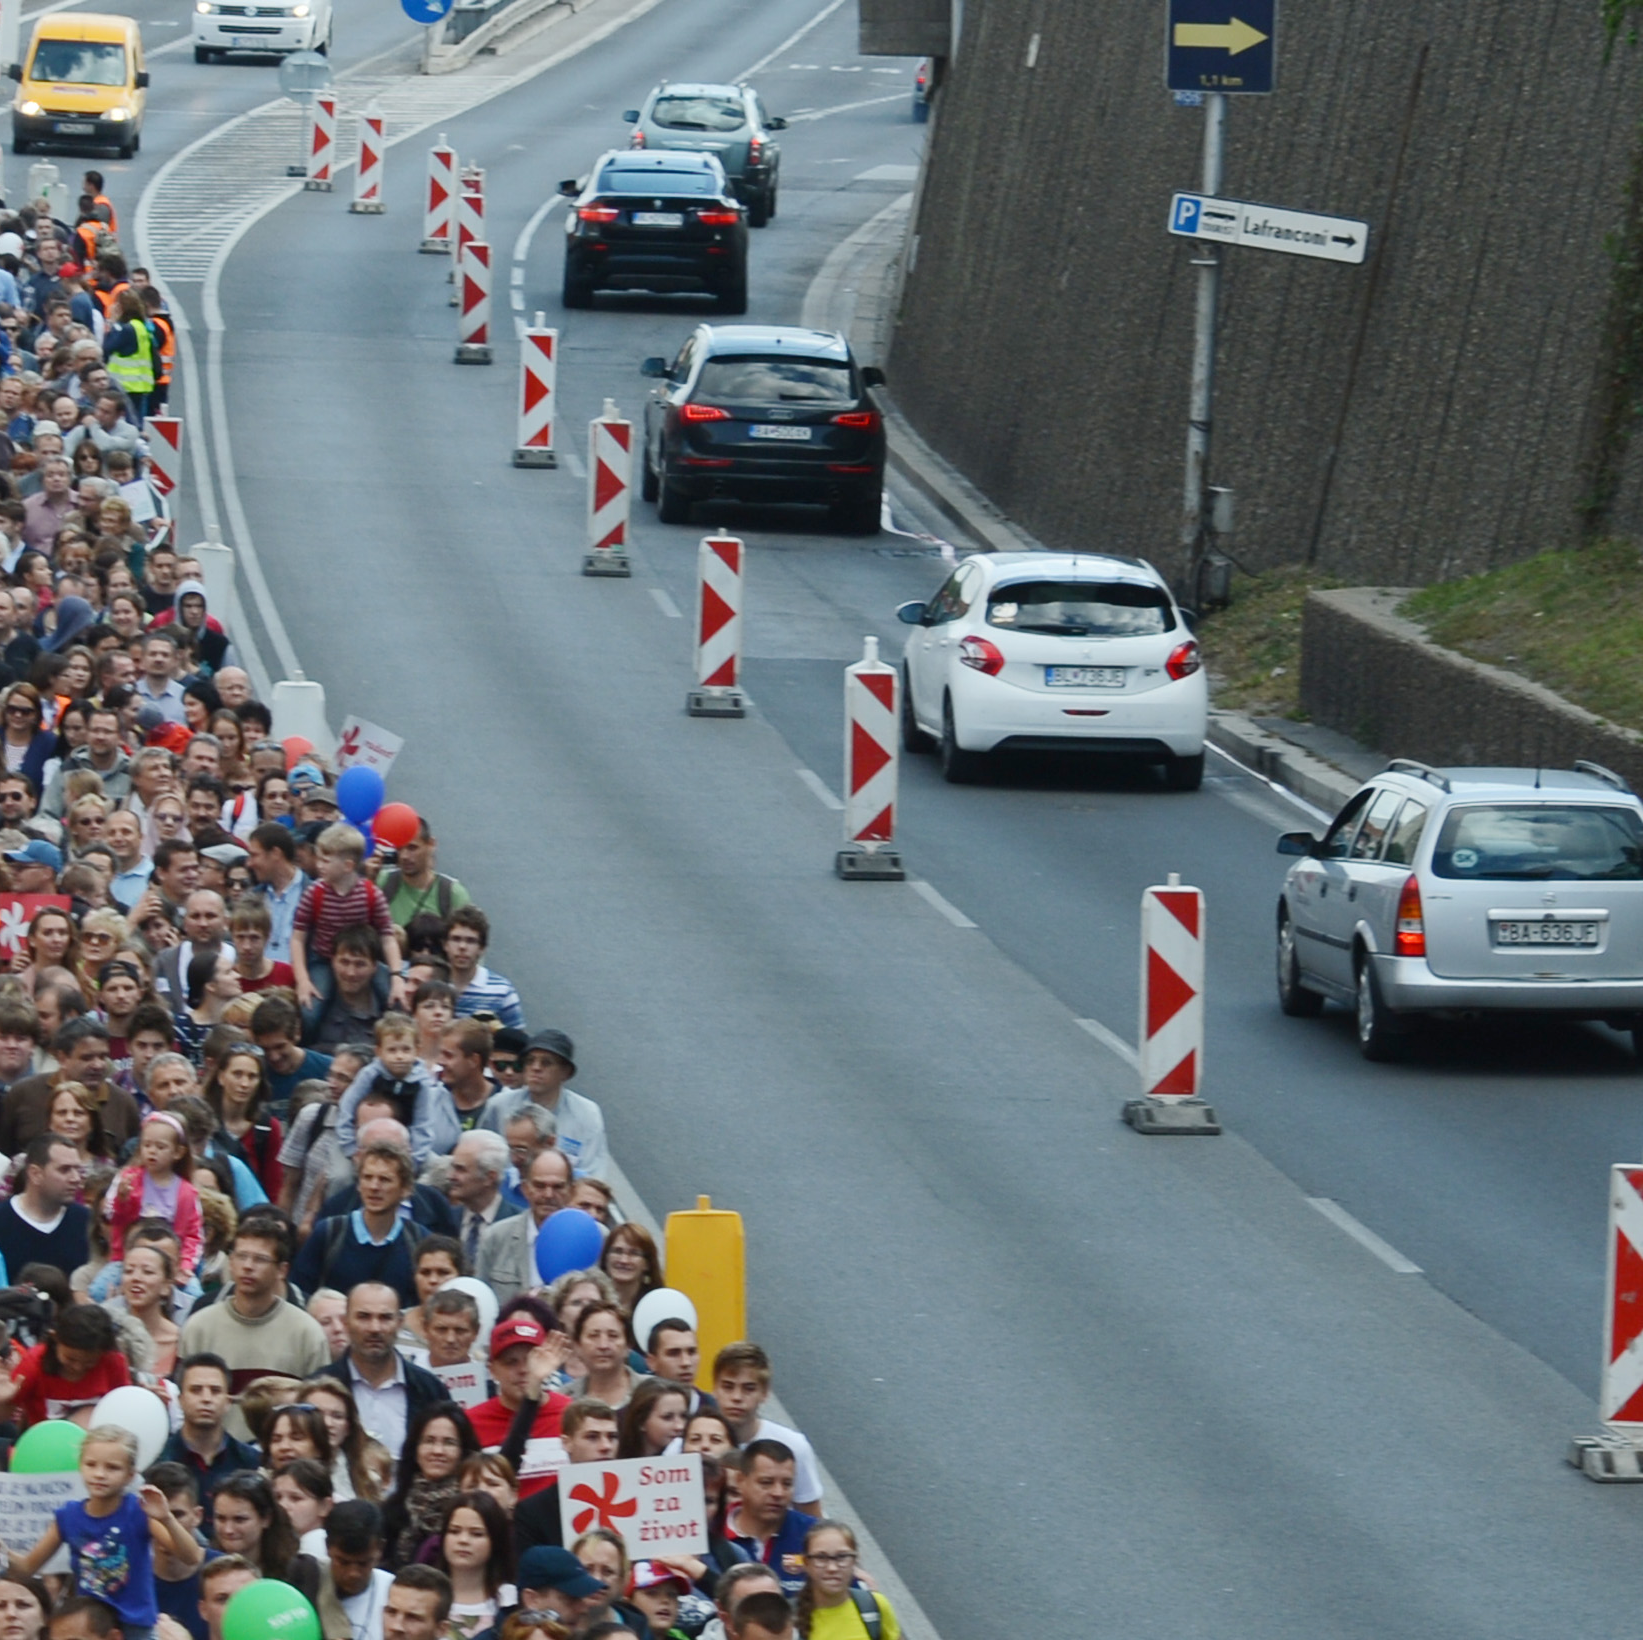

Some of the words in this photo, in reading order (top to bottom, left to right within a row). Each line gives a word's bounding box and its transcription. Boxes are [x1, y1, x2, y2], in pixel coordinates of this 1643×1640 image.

[1178, 201, 1196, 225] P
[1244, 215, 1329, 246] Lafranconi
[638, 1464, 691, 1488] Som
[653, 1494, 682, 1514] za
[638, 1517, 701, 1543] život
